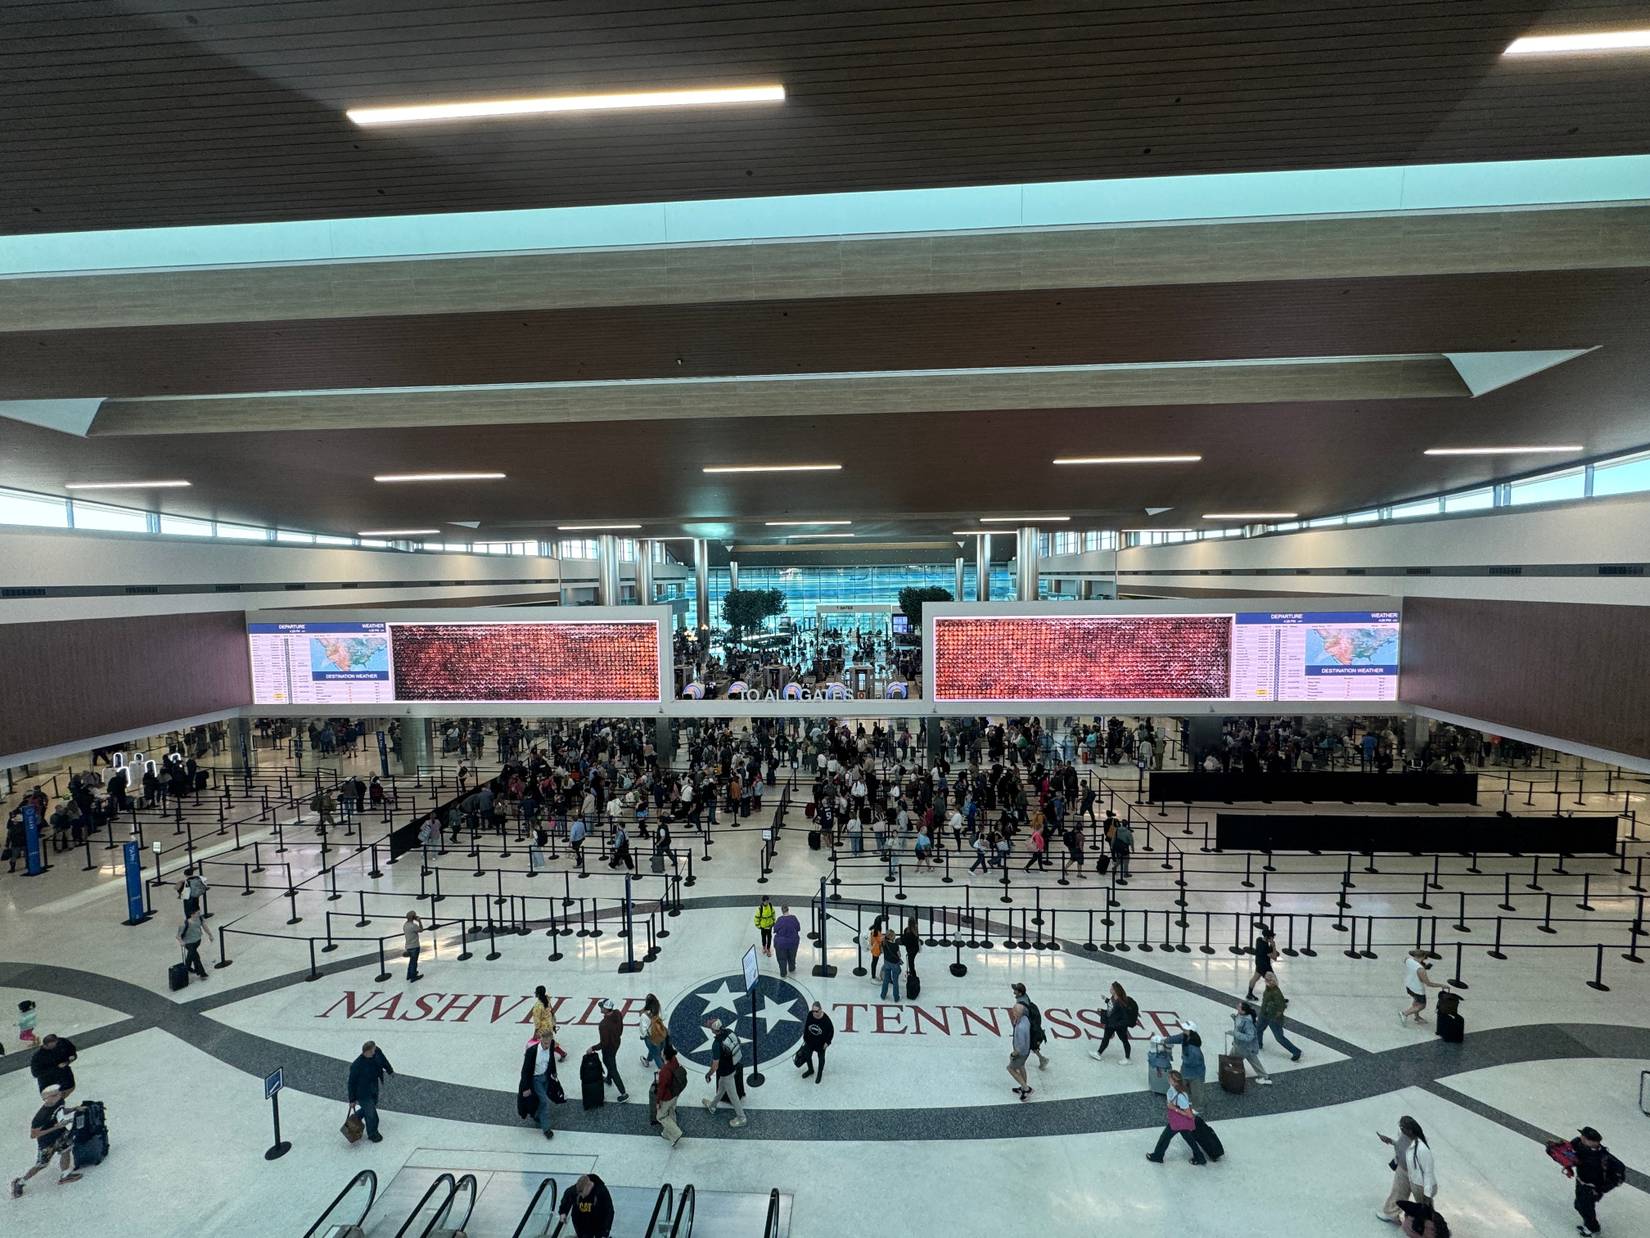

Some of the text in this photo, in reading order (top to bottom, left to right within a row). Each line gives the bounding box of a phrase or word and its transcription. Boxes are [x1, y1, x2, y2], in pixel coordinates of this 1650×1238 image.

[737, 688, 760, 702] TO
[800, 688, 854, 702] GATES
[579, 1201, 592, 1212] CAT
